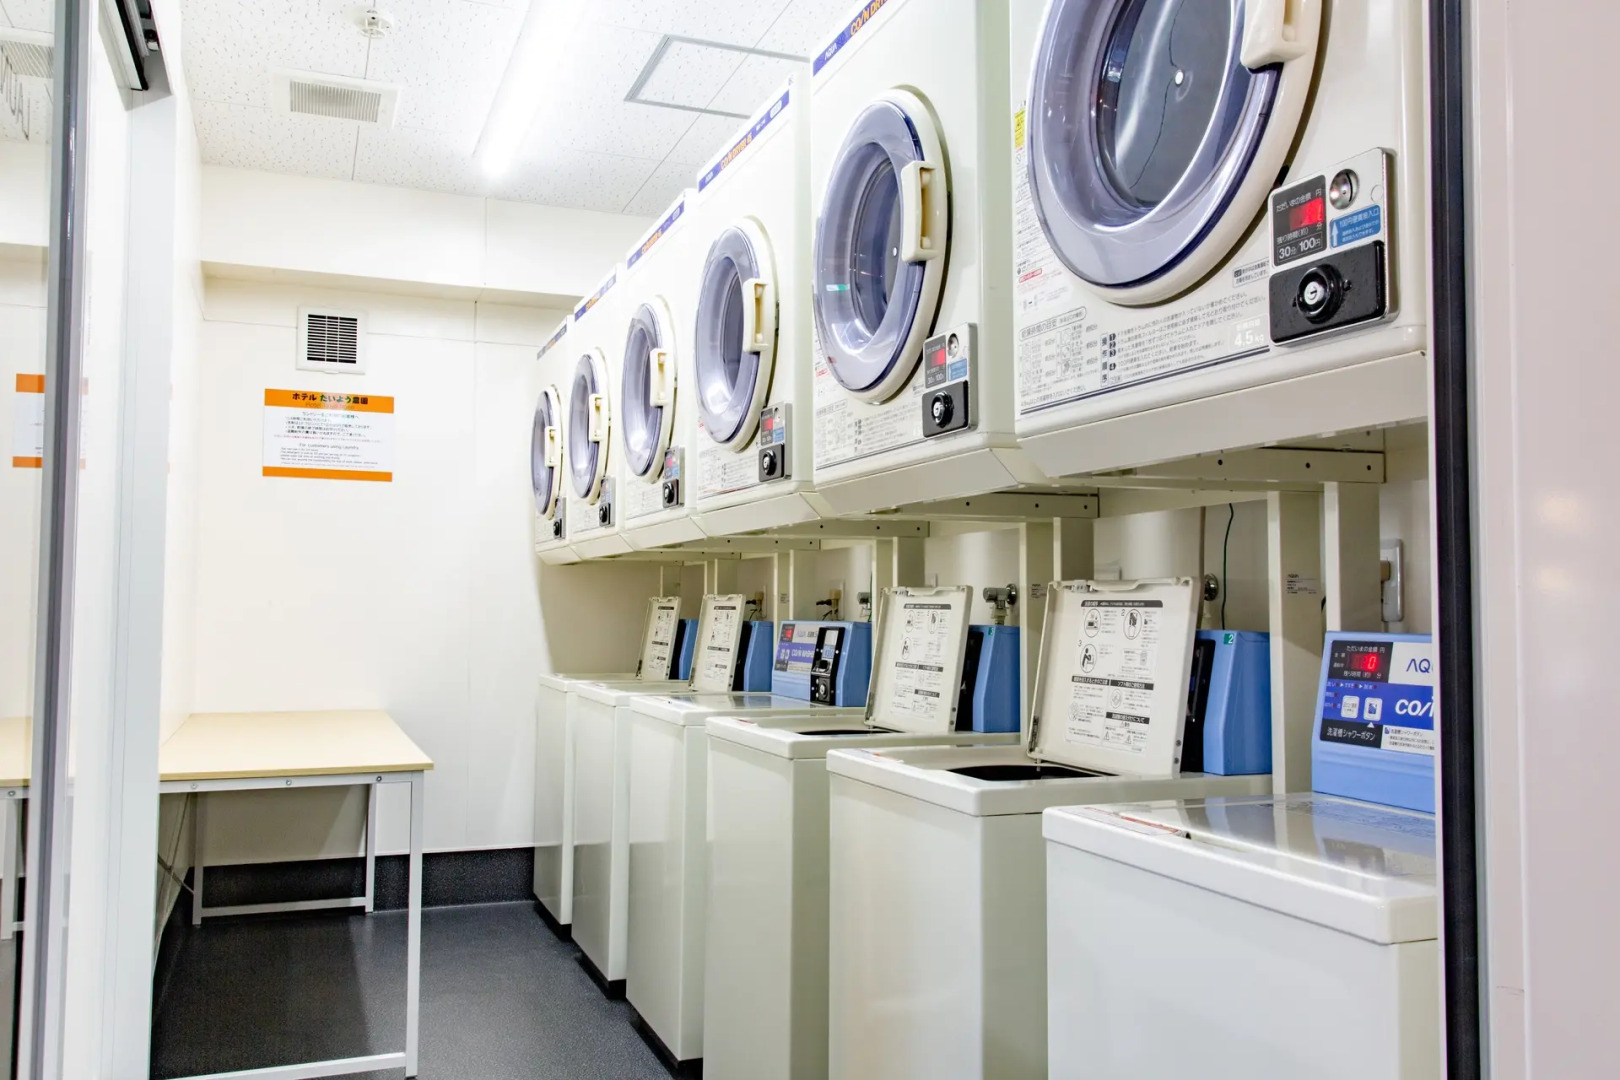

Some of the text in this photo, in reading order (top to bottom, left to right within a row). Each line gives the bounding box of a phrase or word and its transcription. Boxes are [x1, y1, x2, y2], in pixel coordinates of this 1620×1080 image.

[1279, 237, 1321, 259] 30分 100円
[292, 392, 317, 401] ホテル
[1228, 634, 1234, 644] 2
[1346, 645, 1378, 653] ただいまの金額
[1406, 658, 1434, 673] AQ
[1326, 727, 1376, 741] 洗濯槽シャワーボタン
